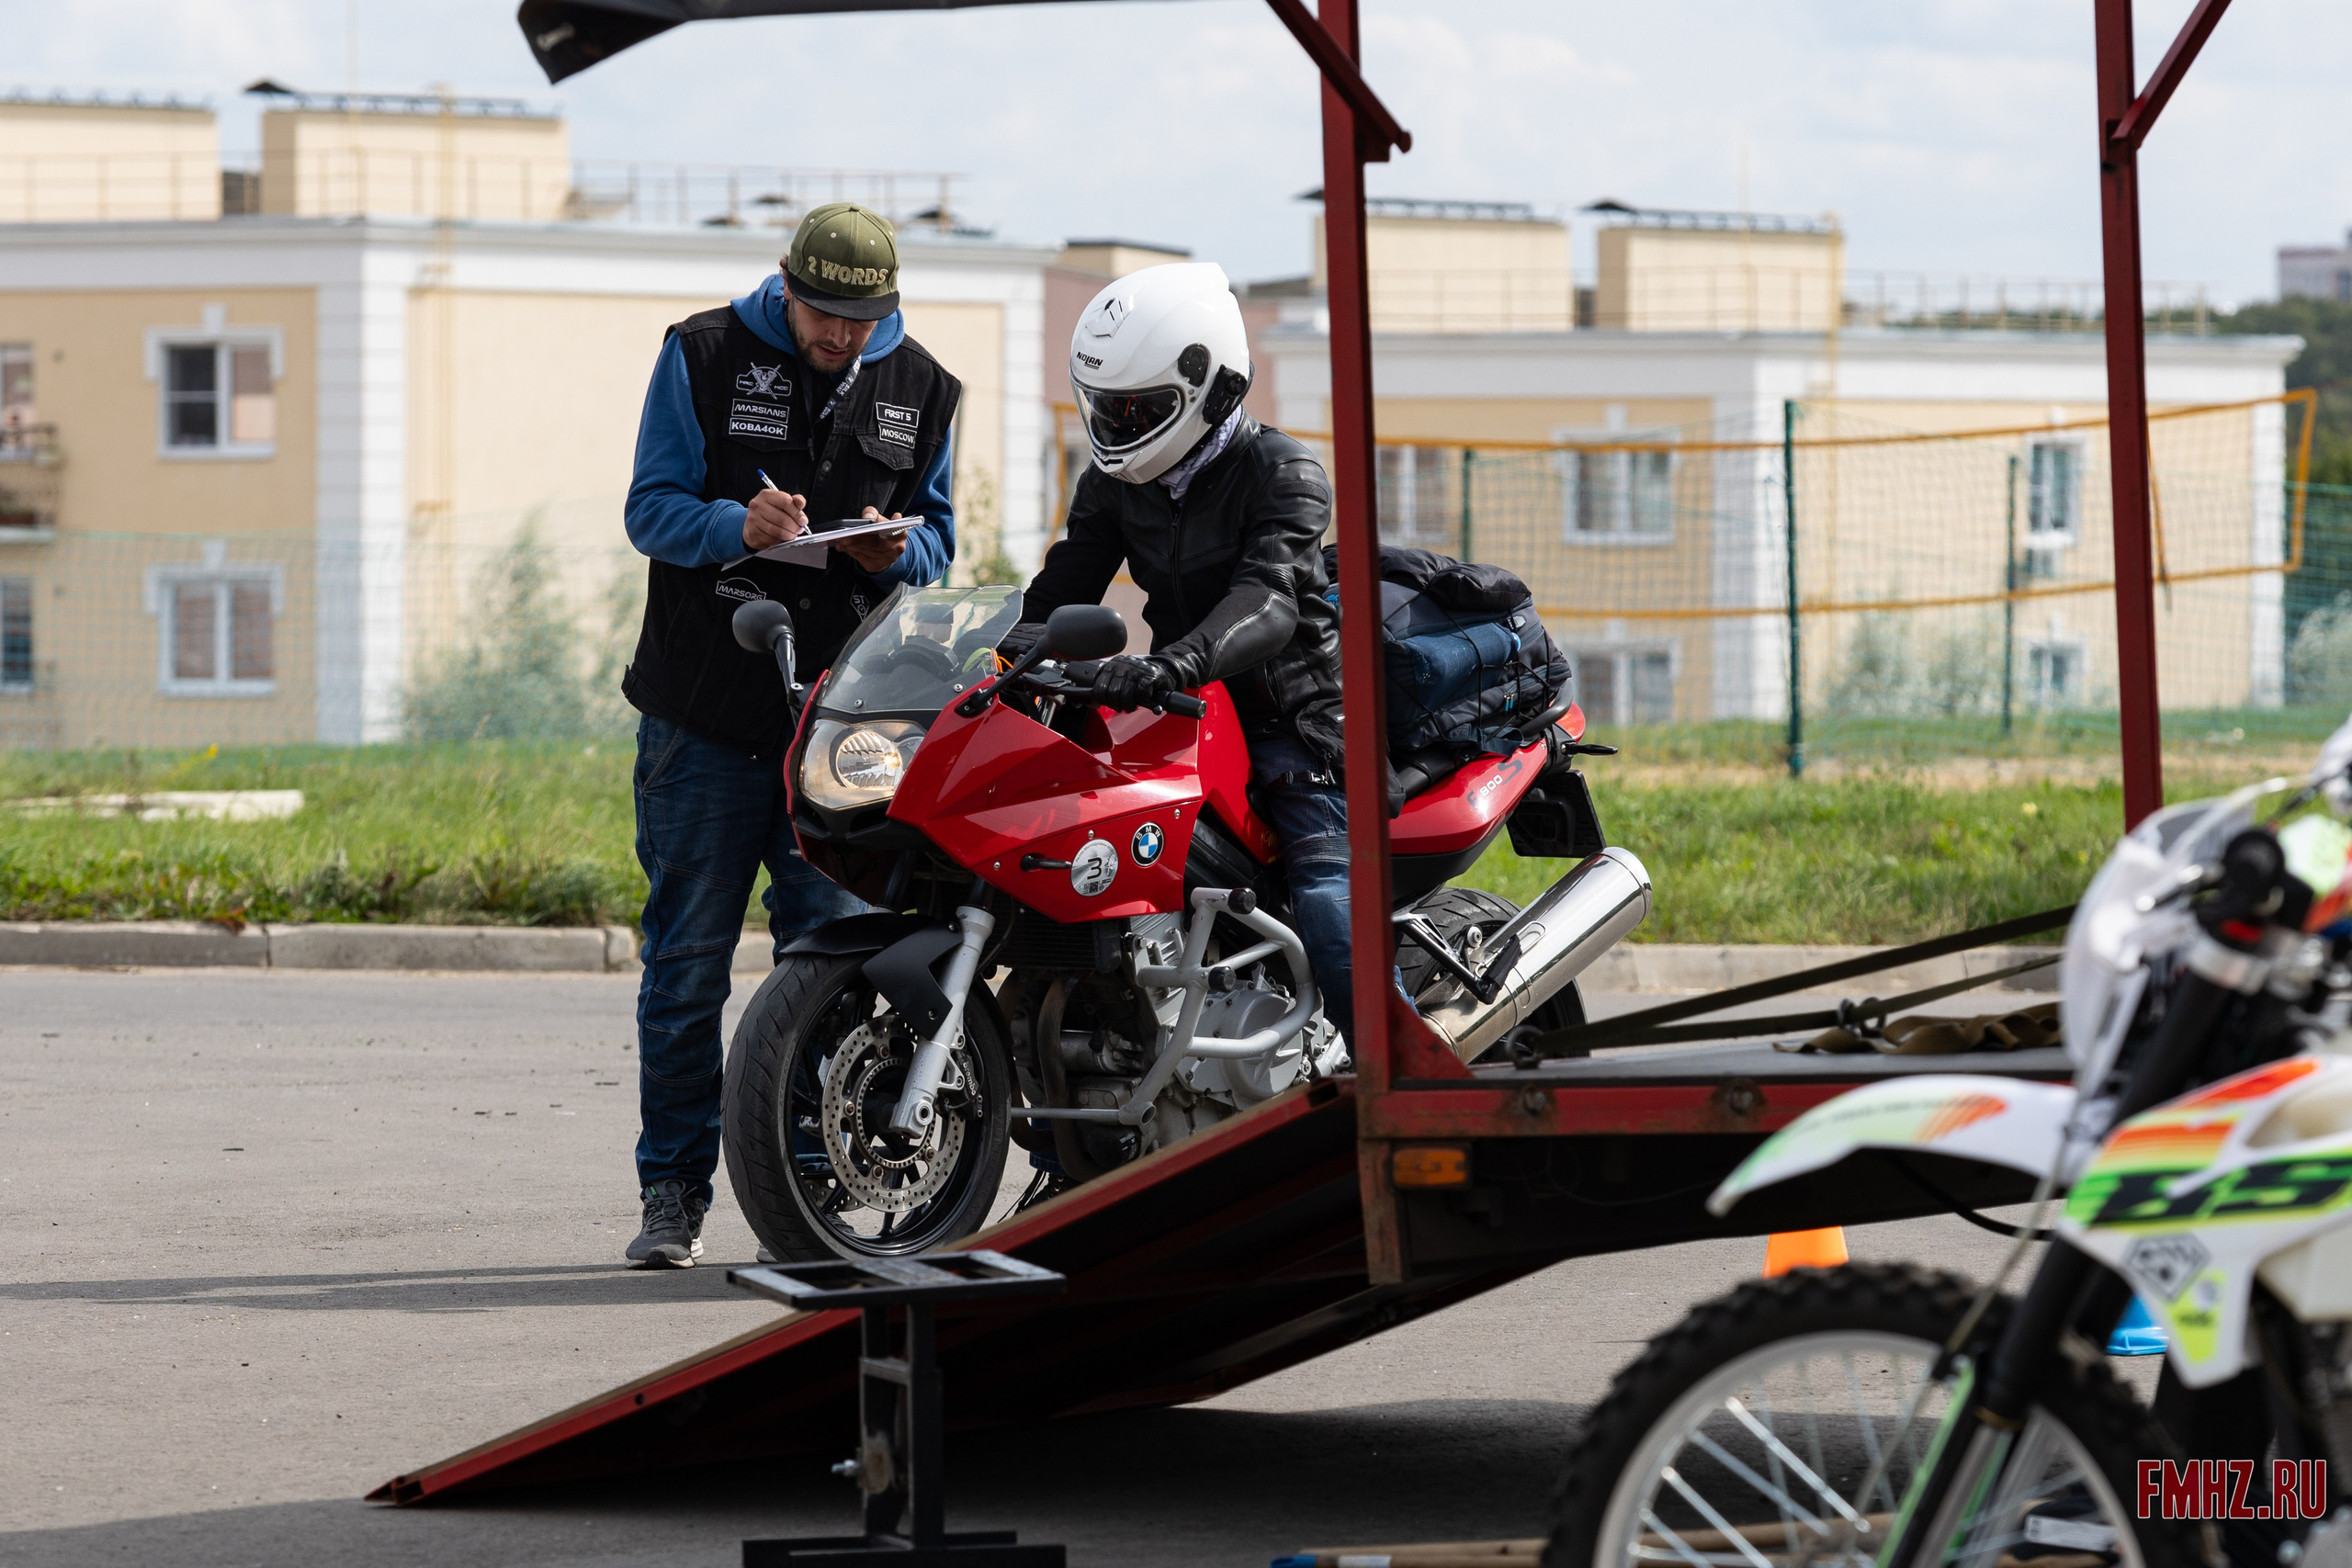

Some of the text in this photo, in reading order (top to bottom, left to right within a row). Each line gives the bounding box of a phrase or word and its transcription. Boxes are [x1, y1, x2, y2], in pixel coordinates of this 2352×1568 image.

[808, 255, 889, 286] 2 WORDS
[1076, 351, 1103, 367] NOLAN
[734, 403, 787, 418] MARSIANS
[905, 412, 911, 422] 5
[731, 421, 785, 435] KOBA4OK
[881, 428, 915, 444] MOSCOW
[1479, 774, 1503, 796] 800
[1498, 759, 1523, 786] S
[1136, 825, 1161, 840] BMW
[1087, 857, 1102, 879] 3
[963, 1061, 977, 1096] brembo
